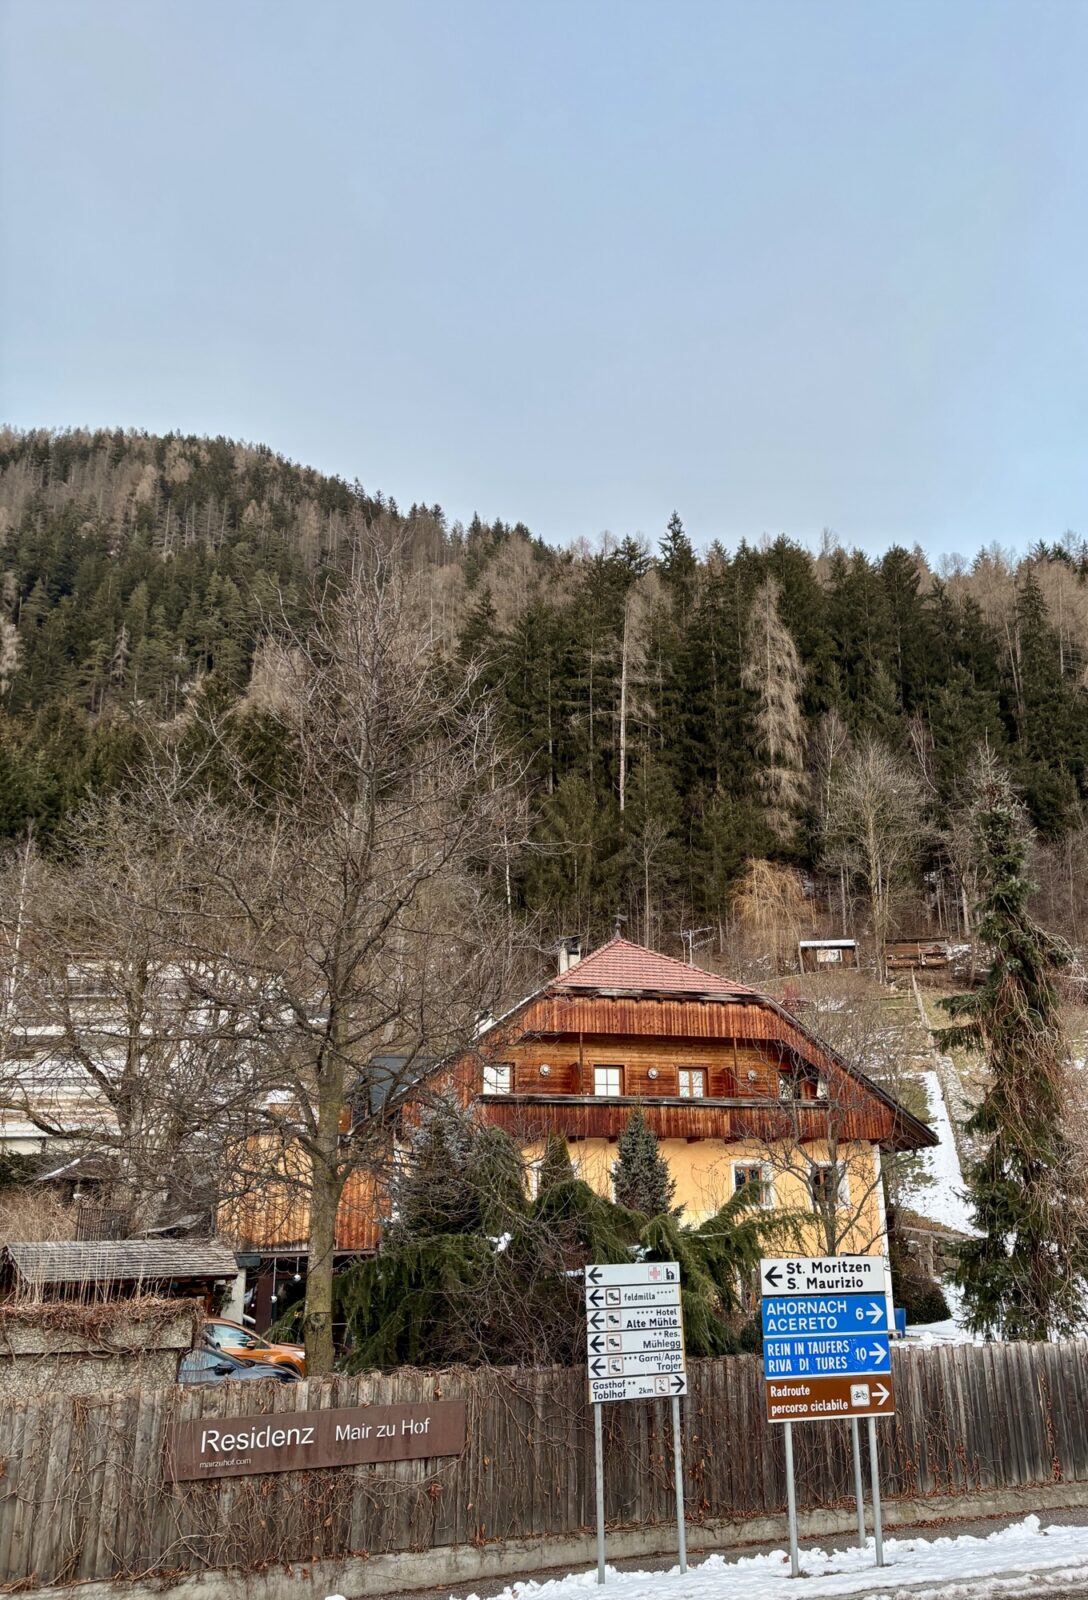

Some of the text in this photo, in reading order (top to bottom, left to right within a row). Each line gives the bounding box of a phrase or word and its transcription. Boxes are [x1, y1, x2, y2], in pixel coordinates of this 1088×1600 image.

[787, 1262, 870, 1274] St. Moritzen
[787, 1278, 863, 1289] S. Maurizio
[624, 1292, 655, 1300] feldmilla
[767, 1301, 864, 1320] AHORNACH 6
[627, 1318, 677, 1328] Alte Mühle
[767, 1317, 837, 1331] ACERETO
[643, 1340, 681, 1349] Mühlegg
[768, 1340, 866, 1361] REIN IN TAUFERS 10
[657, 1362, 682, 1371] Trojer
[769, 1357, 847, 1372] RIVA DI TURES
[593, 1380, 626, 1390] Gasthof
[771, 1385, 810, 1397] Radroute
[593, 1390, 626, 1400] Toblhof
[771, 1400, 848, 1416] percorso ciclabile
[201, 1418, 430, 1453] Residenz Mair zu Hof
[200, 1457, 251, 1469] mairzuhof.com
